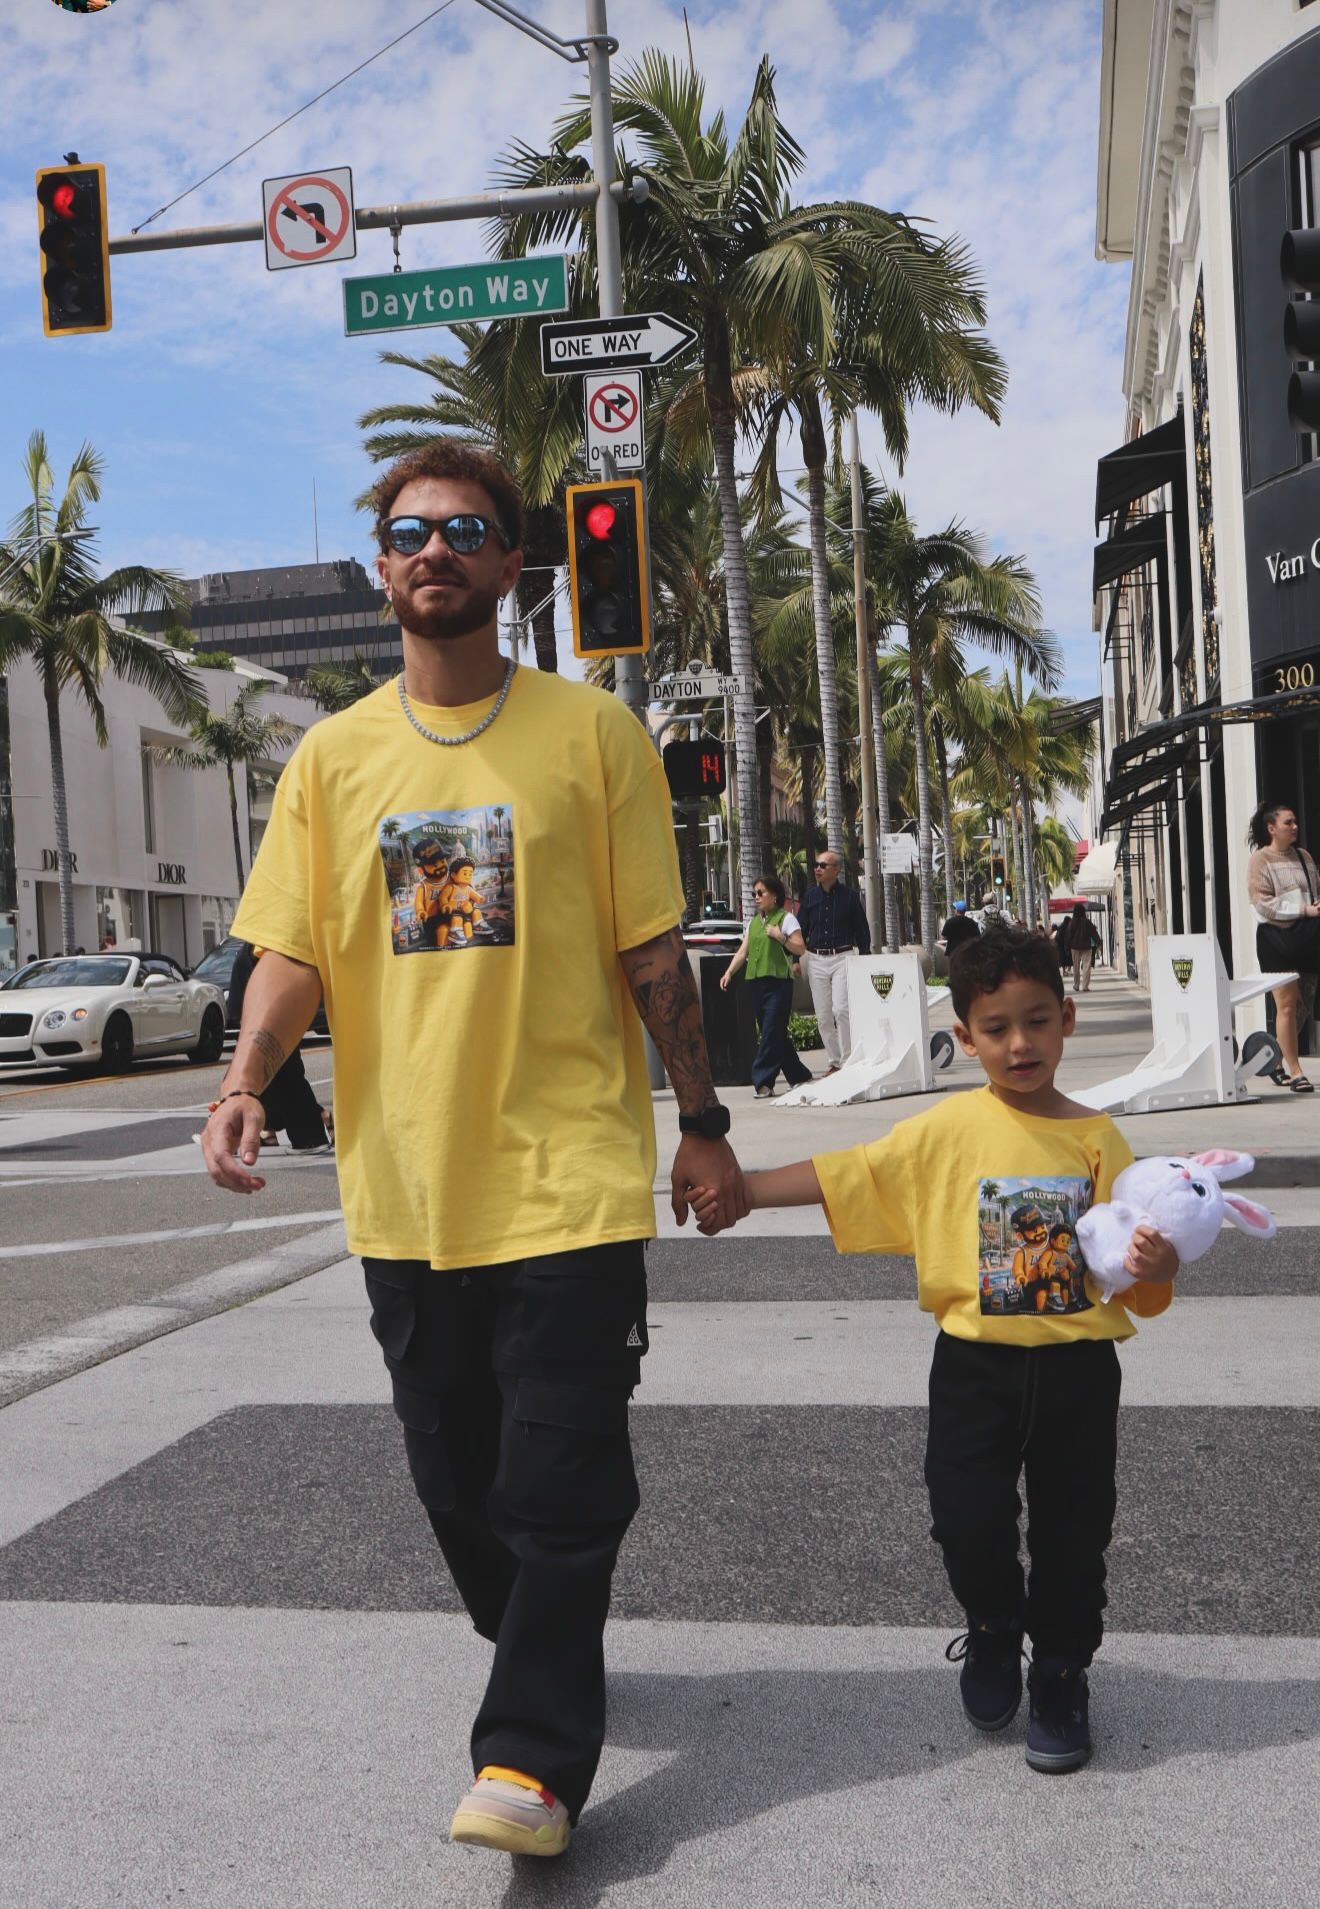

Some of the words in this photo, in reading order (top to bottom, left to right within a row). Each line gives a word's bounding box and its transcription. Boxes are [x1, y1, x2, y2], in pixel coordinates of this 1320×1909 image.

[360, 284, 473, 321] Dayton
[486, 275, 549, 307] Way
[554, 338, 592, 358] ONE
[602, 333, 642, 353] WAY
[591, 445, 609, 461] O
[613, 443, 639, 459] RED
[1265, 552, 1304, 584] Van
[653, 681, 702, 699] DAYTON
[717, 677, 727, 685] WY
[717, 684, 740, 694] 9400
[1275, 663, 1314, 693] 300
[701, 752, 720, 783] 14
[422, 825, 468, 835] HOLLYWOOD
[42, 849, 79, 873] DIR
[158, 862, 187, 884] DIOR
[1023, 1191, 1066, 1201] HOLLYWOOD
